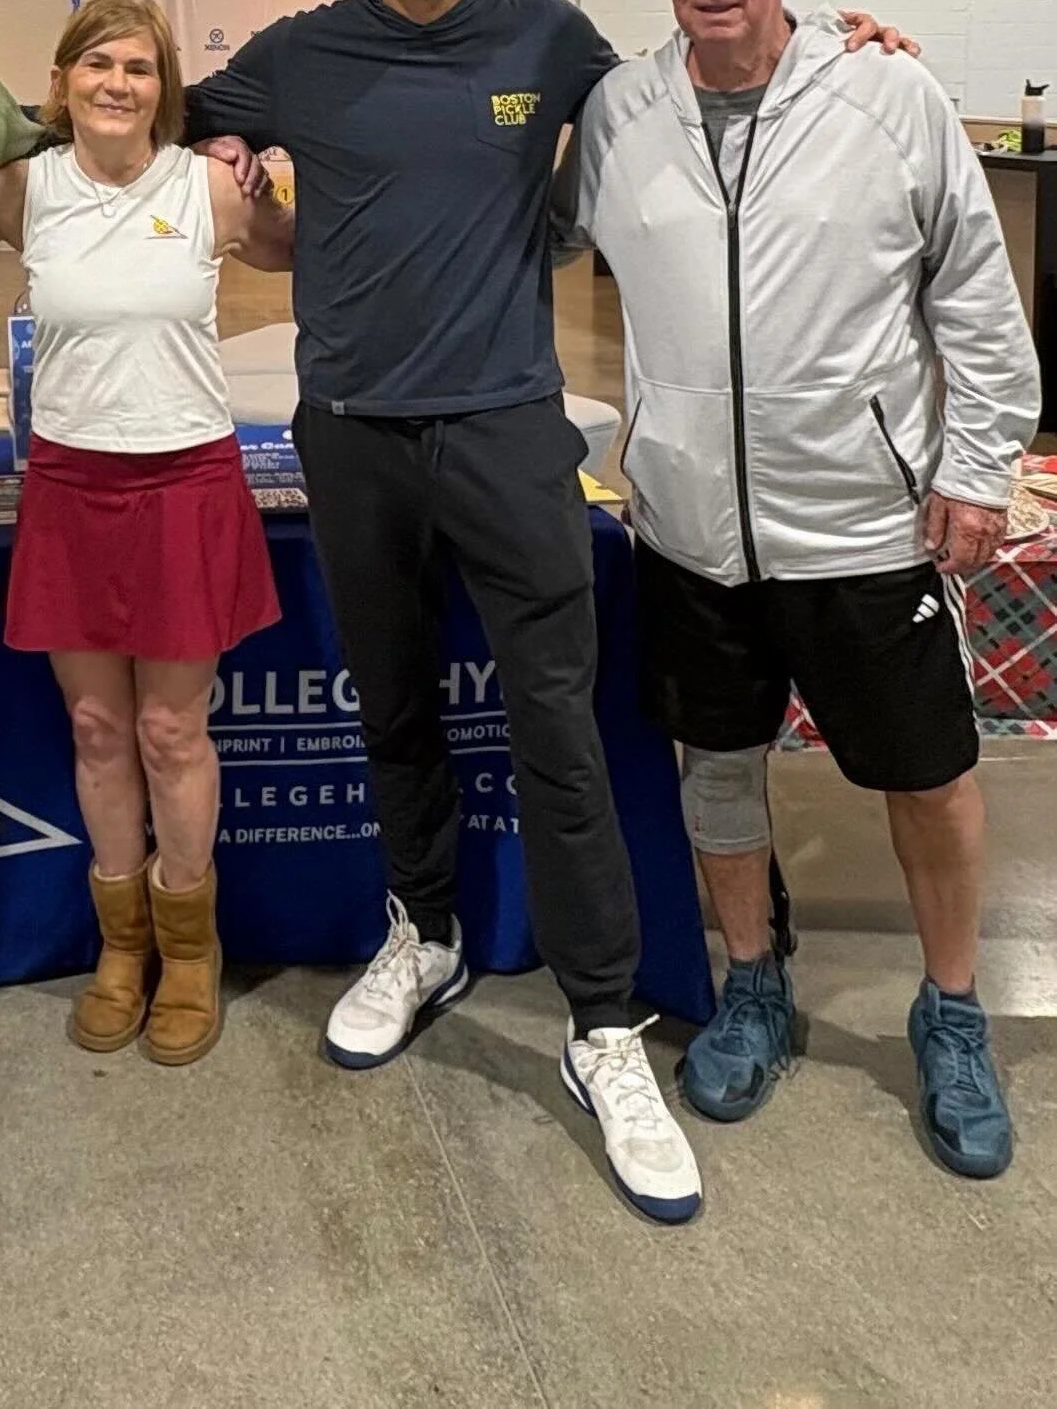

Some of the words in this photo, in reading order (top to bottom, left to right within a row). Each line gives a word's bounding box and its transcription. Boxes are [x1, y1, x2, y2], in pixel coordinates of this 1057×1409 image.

[491, 92, 541, 106] BOSTON
[493, 103, 536, 115] PICKLE
[495, 114, 527, 126] CLUB
[218, 828, 232, 844] A
[467, 814, 490, 831] AT
[493, 815, 507, 833] A
